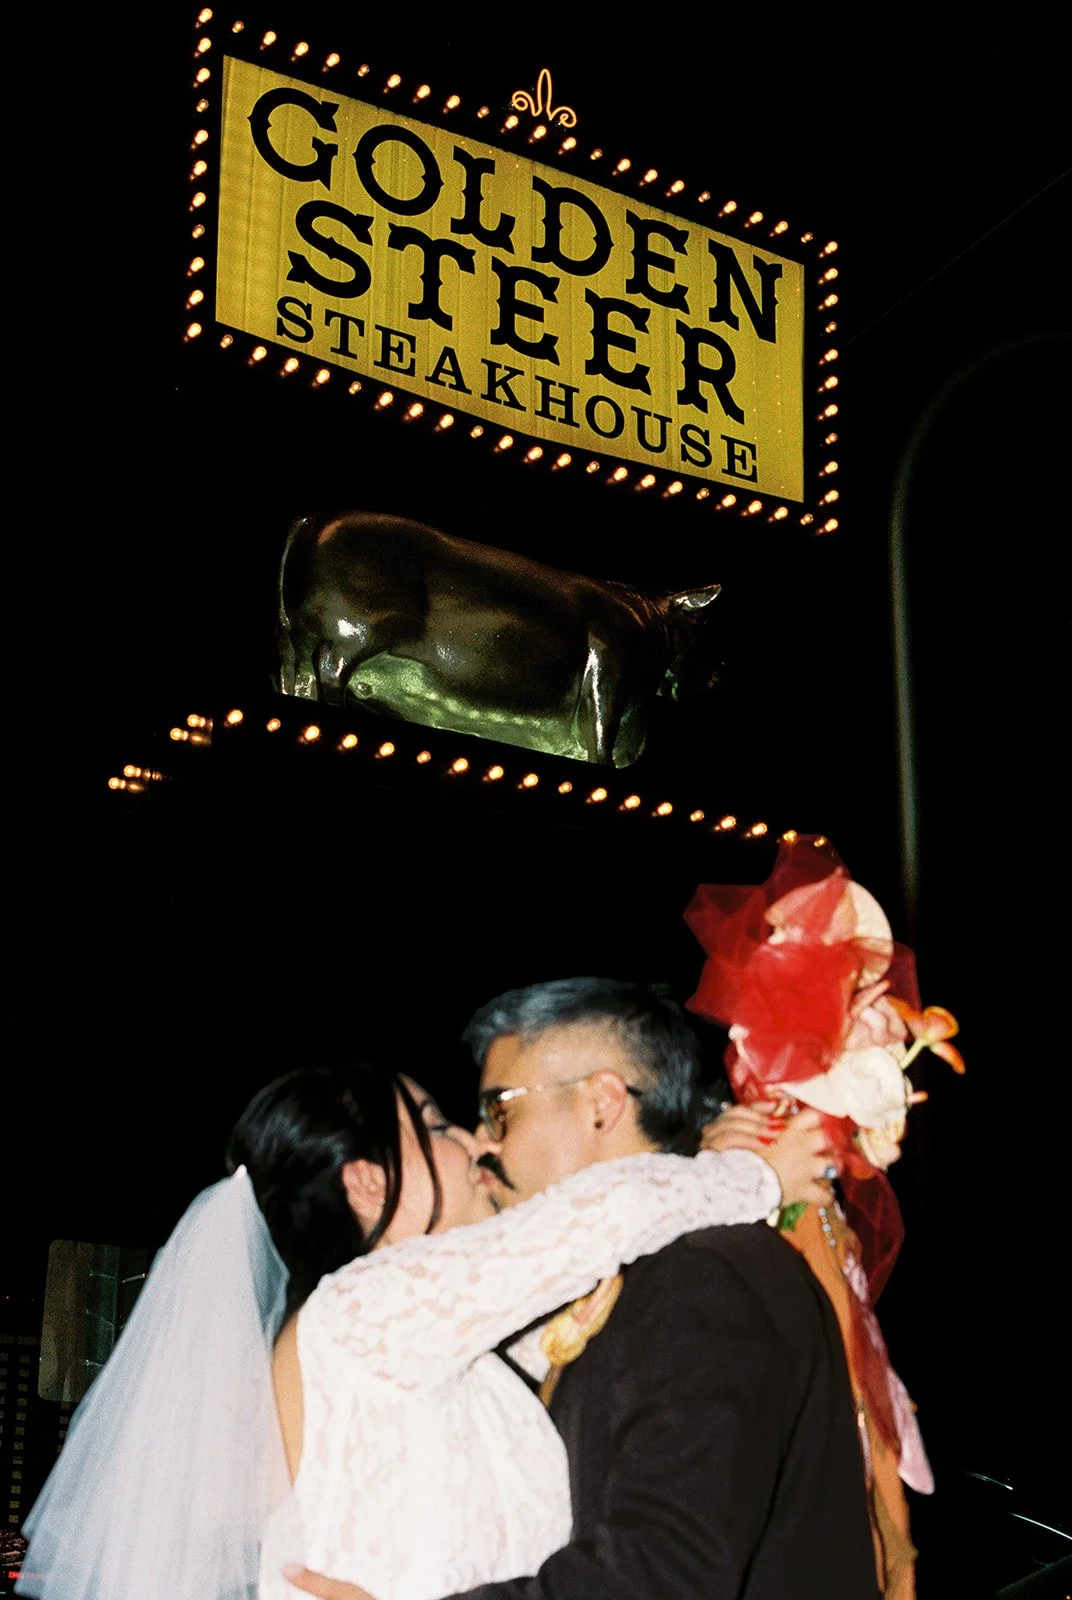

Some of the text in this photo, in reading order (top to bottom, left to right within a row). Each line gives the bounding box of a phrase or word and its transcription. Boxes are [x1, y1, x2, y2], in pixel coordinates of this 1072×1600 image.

[247, 87, 782, 343] GOLDEN
[286, 200, 745, 424] STEER
[275, 295, 758, 483] STEAKHOUSE
